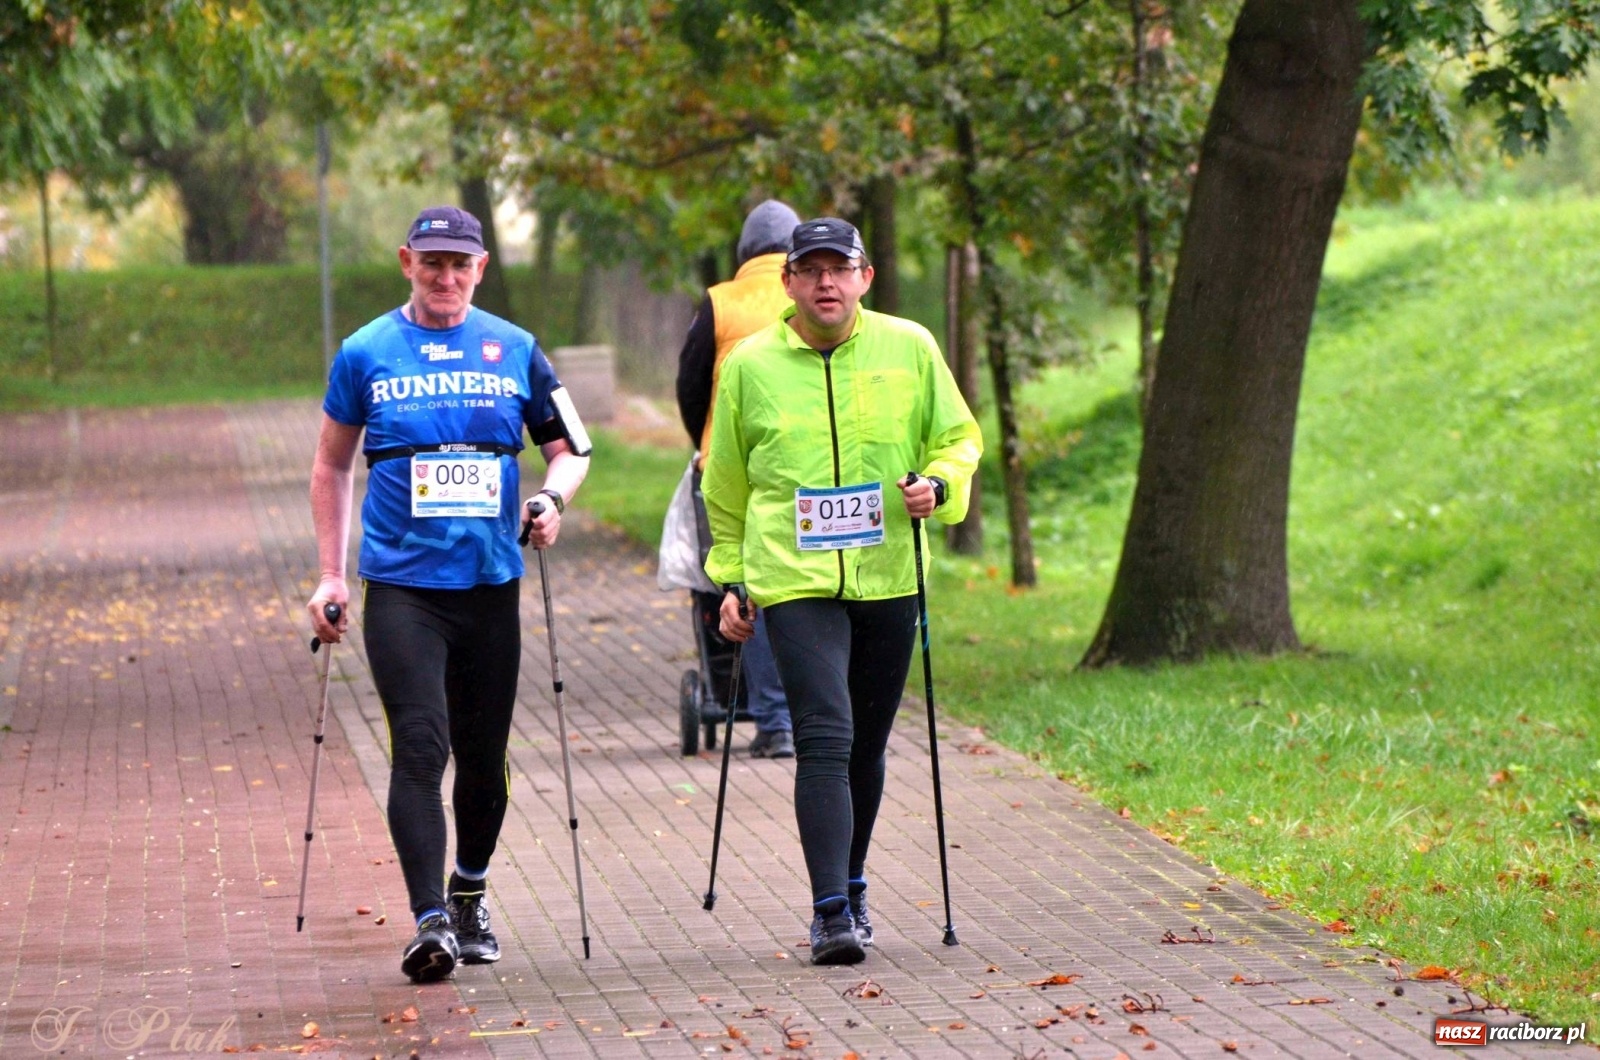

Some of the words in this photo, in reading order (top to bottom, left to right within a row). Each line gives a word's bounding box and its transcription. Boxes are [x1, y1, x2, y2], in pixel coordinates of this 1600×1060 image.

[371, 371, 519, 404] RUNNERS
[462, 400, 495, 408] TEAM
[436, 464, 480, 485] 008
[819, 496, 862, 520] 012
